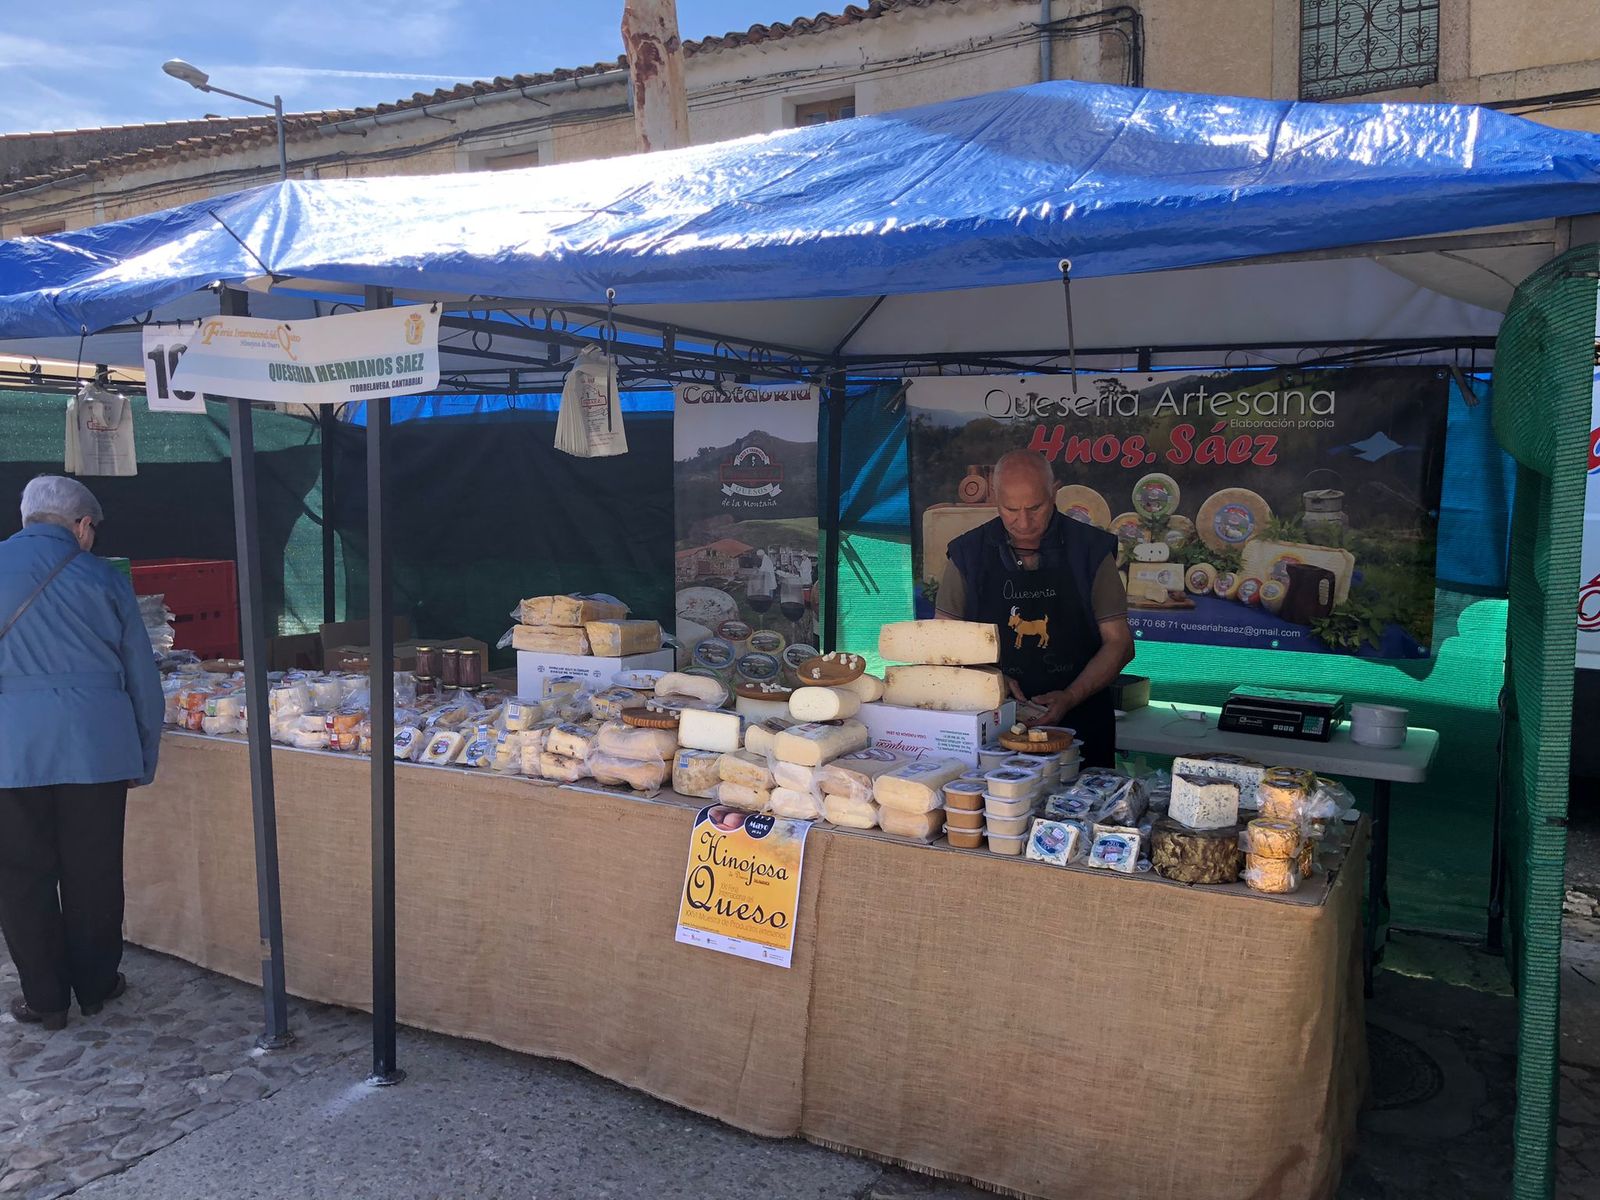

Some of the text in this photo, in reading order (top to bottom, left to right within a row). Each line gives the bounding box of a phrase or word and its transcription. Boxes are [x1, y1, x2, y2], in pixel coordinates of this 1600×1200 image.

[268, 353, 425, 384] QUESERIA HERMANOS SAEZ
[1152, 385, 1336, 417] Artesana
[1230, 417, 1335, 430] Elaboración propia
[1027, 421, 1279, 469] Hnos. Sáez
[1142, 618, 1153, 627] 70
[1155, 619, 1166, 628] 68
[1168, 620, 1178, 629] 71
[1181, 622, 1301, 638] queseriahsaez@gmail.com
[749, 821, 769, 831] Mayo
[698, 831, 789, 886] Hinojosa
[687, 865, 789, 928] Queso
